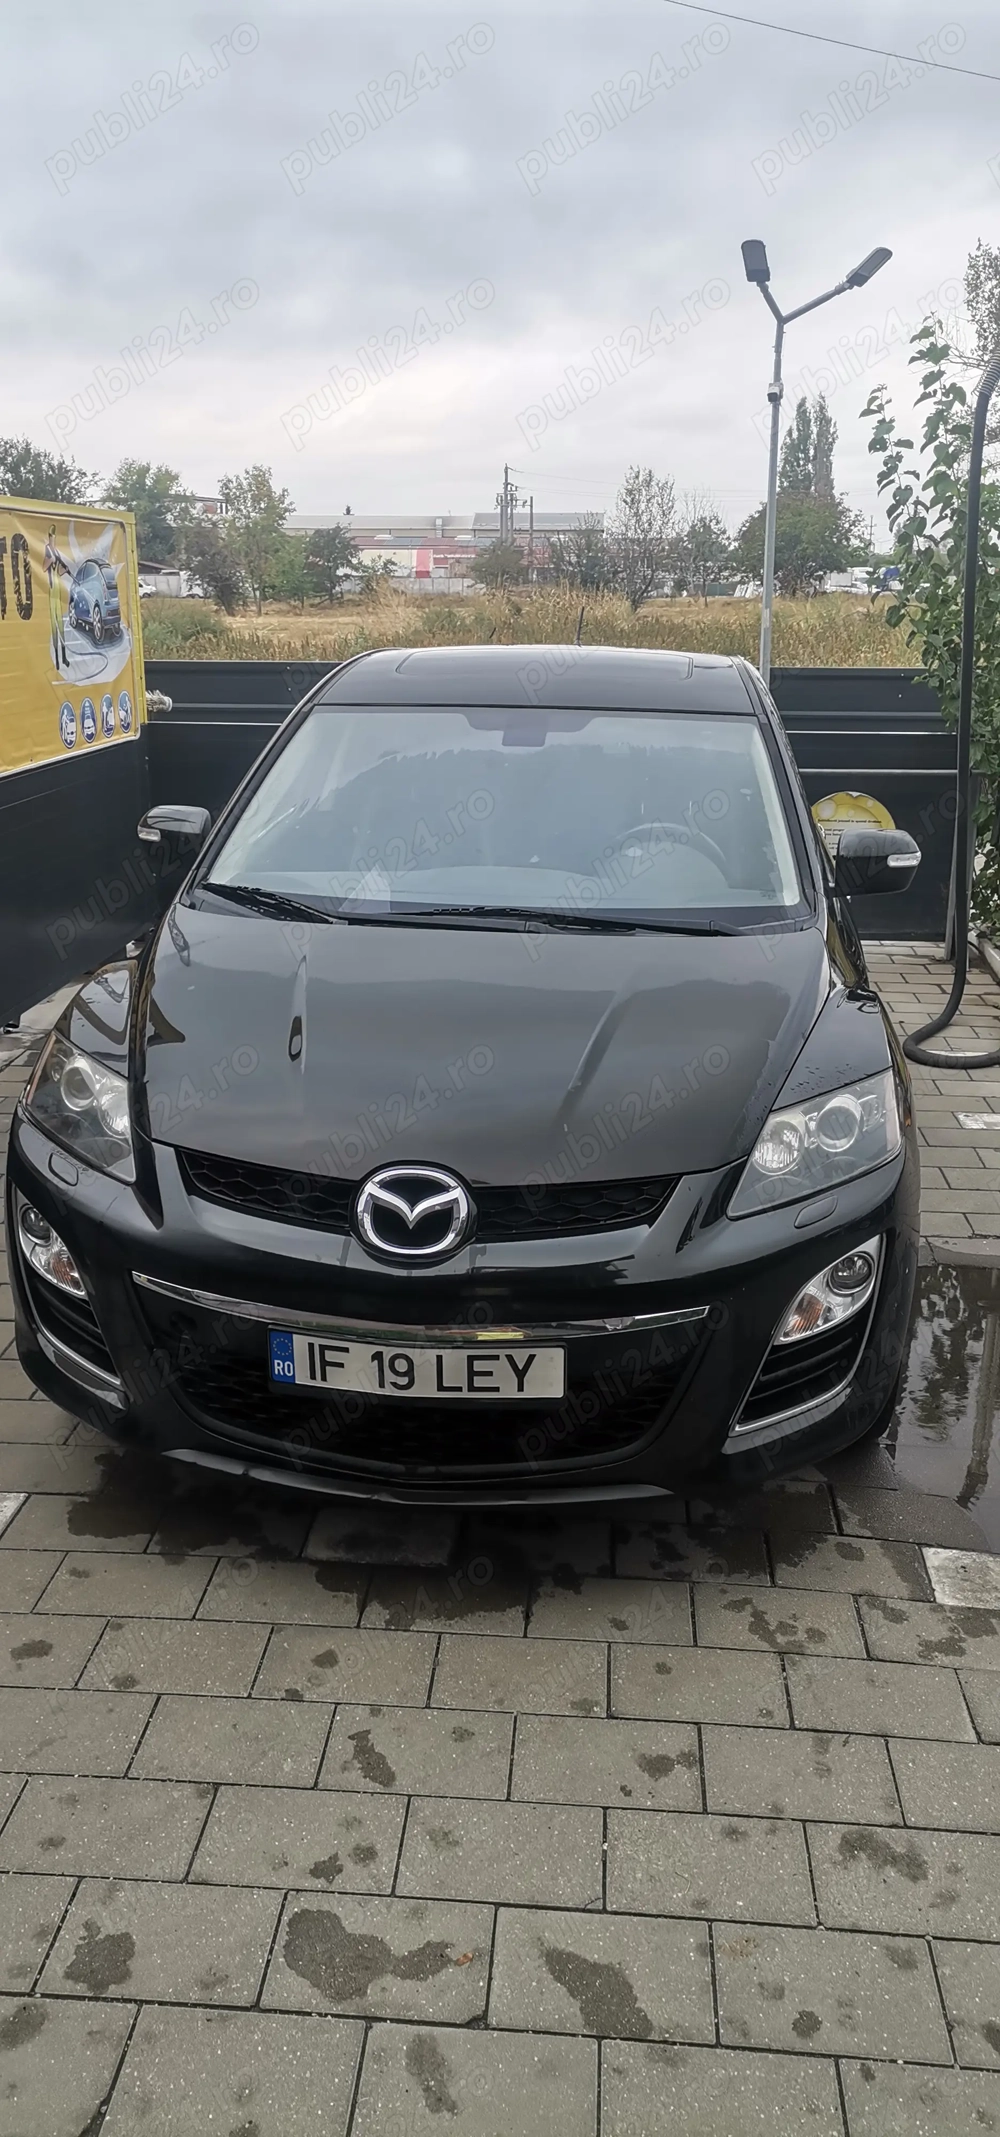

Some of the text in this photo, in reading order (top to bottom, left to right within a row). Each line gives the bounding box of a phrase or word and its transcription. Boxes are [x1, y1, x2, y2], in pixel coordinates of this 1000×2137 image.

[274, 1359, 294, 1377] RO
[307, 1341, 537, 1393] IF 19 LEY
